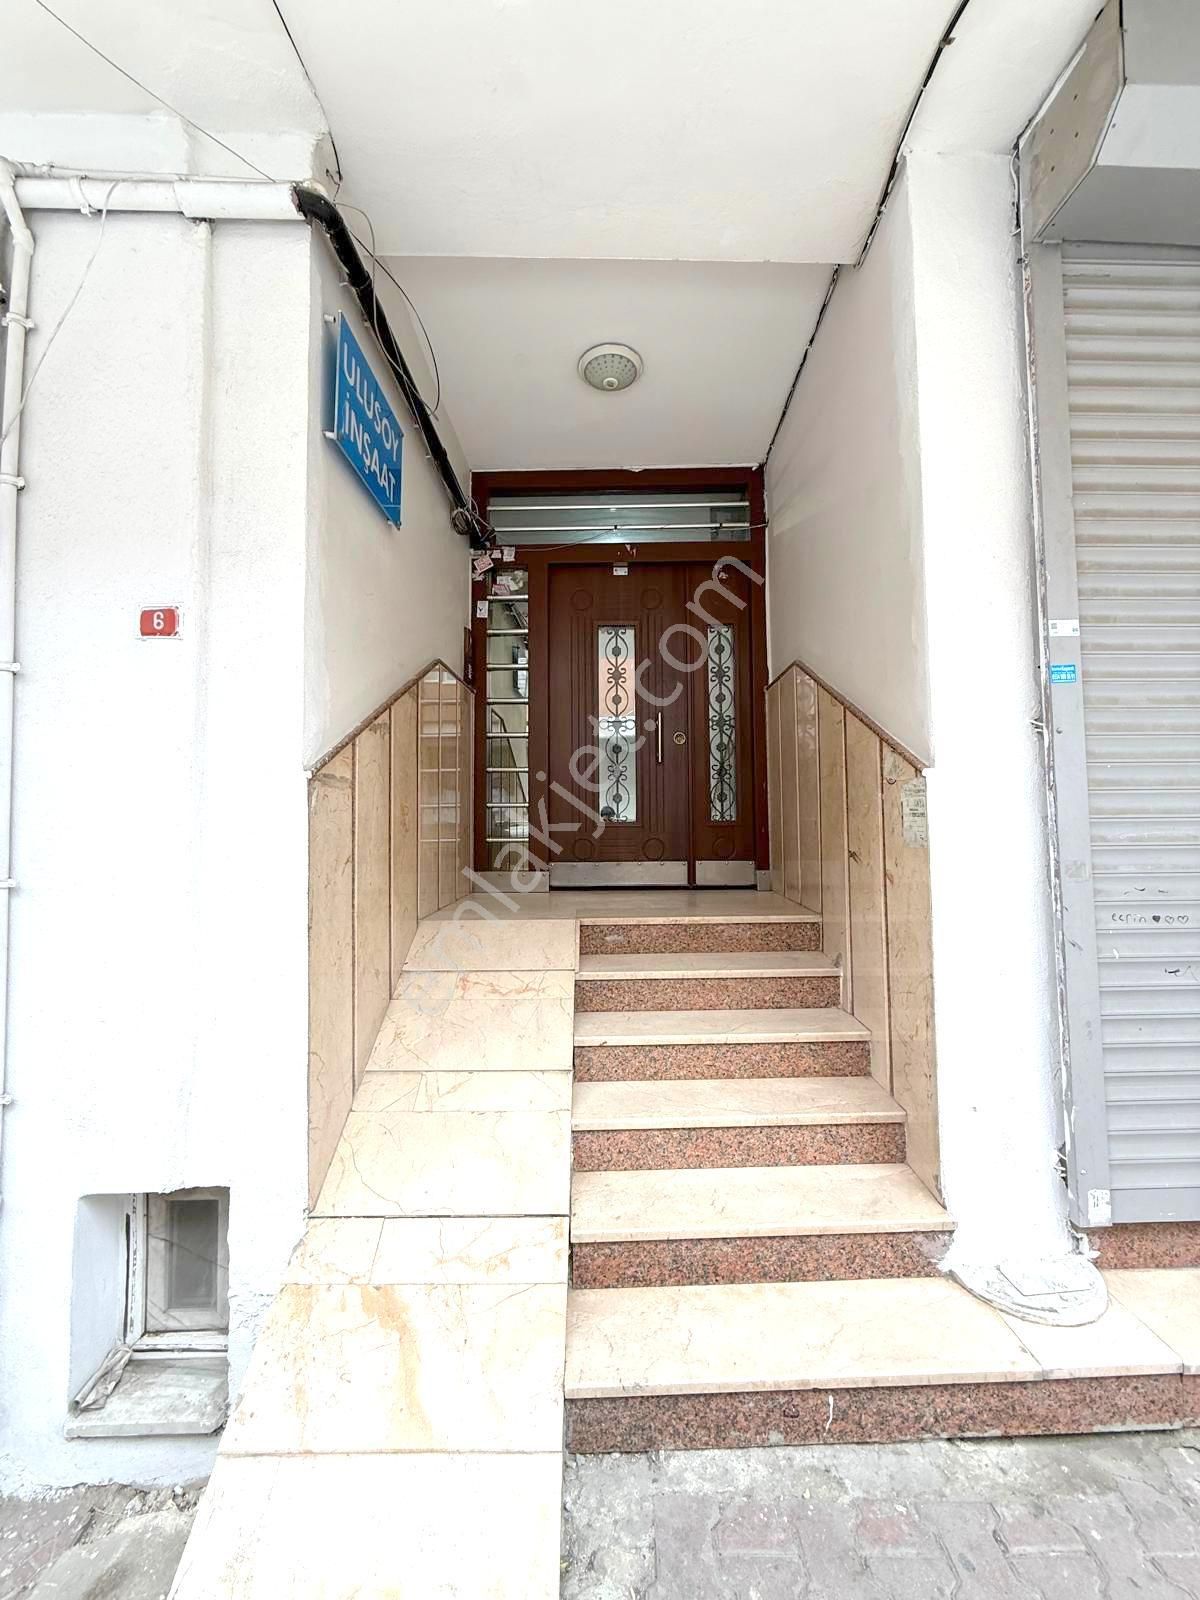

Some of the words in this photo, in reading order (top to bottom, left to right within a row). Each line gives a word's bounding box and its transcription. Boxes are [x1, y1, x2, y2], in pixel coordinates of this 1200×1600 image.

[343, 342, 399, 462] ULUSOY
[343, 391, 396, 503] İNŞAAT
[153, 611, 164, 630] 6
